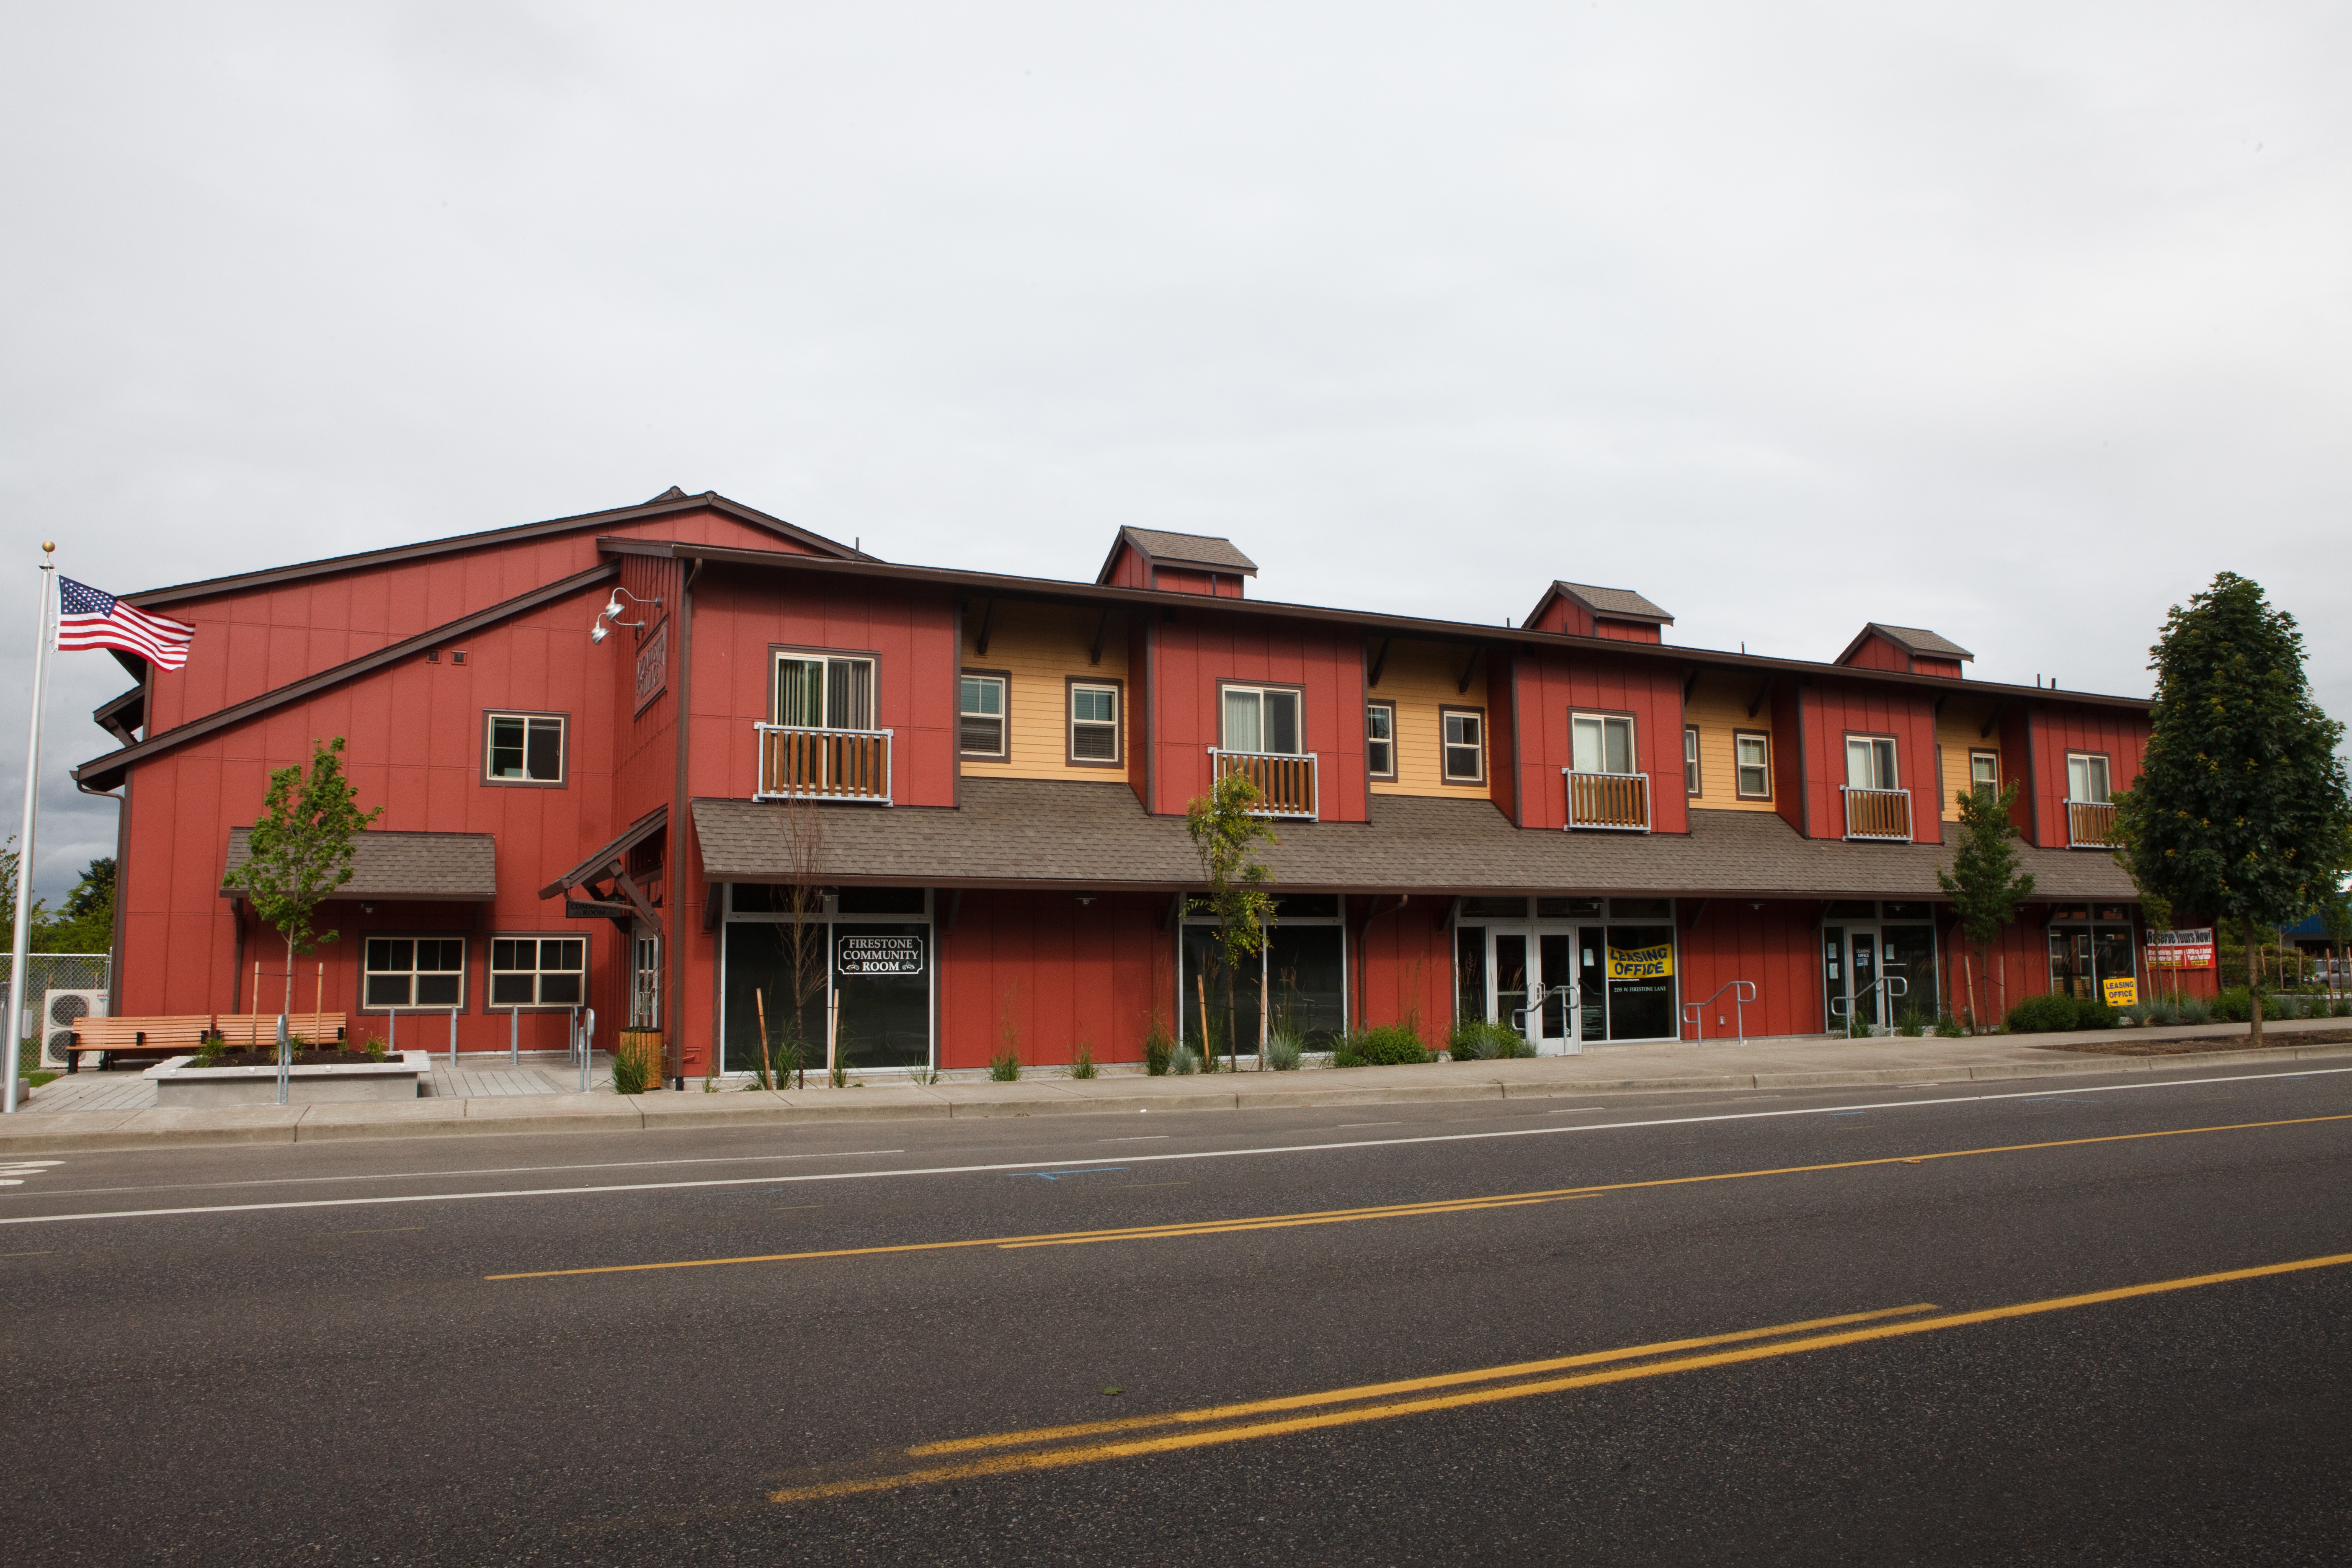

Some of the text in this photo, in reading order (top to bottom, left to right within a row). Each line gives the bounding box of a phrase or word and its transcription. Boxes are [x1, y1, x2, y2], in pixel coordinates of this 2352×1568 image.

[2175, 931, 2195, 944] Yours
[2194, 929, 2211, 943] Now!
[849, 939, 913, 948] FIRESTONE
[843, 950, 919, 960] COMMUNITY
[1610, 947, 1668, 962] LEASING
[862, 962, 900, 971] ROOM
[1614, 961, 1665, 976] OFFICE
[2105, 981, 2134, 989] LEASING
